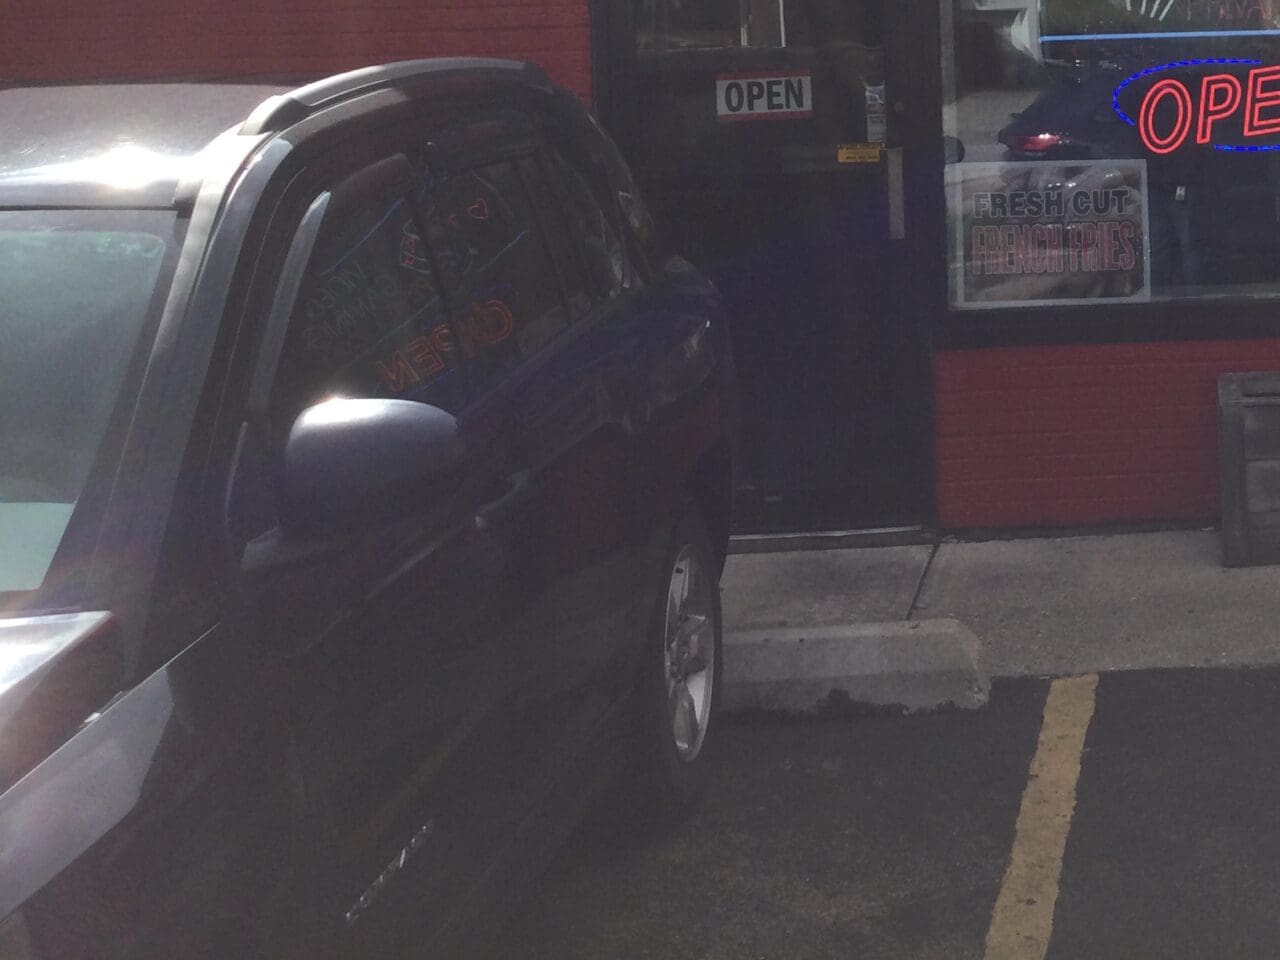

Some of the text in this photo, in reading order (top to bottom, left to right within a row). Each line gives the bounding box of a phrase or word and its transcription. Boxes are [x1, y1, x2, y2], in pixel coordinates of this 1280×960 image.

[724, 78, 804, 112] OPEN
[973, 188, 1130, 219] FRESH CUT
[971, 221, 1136, 275] FRENCH FRIES
